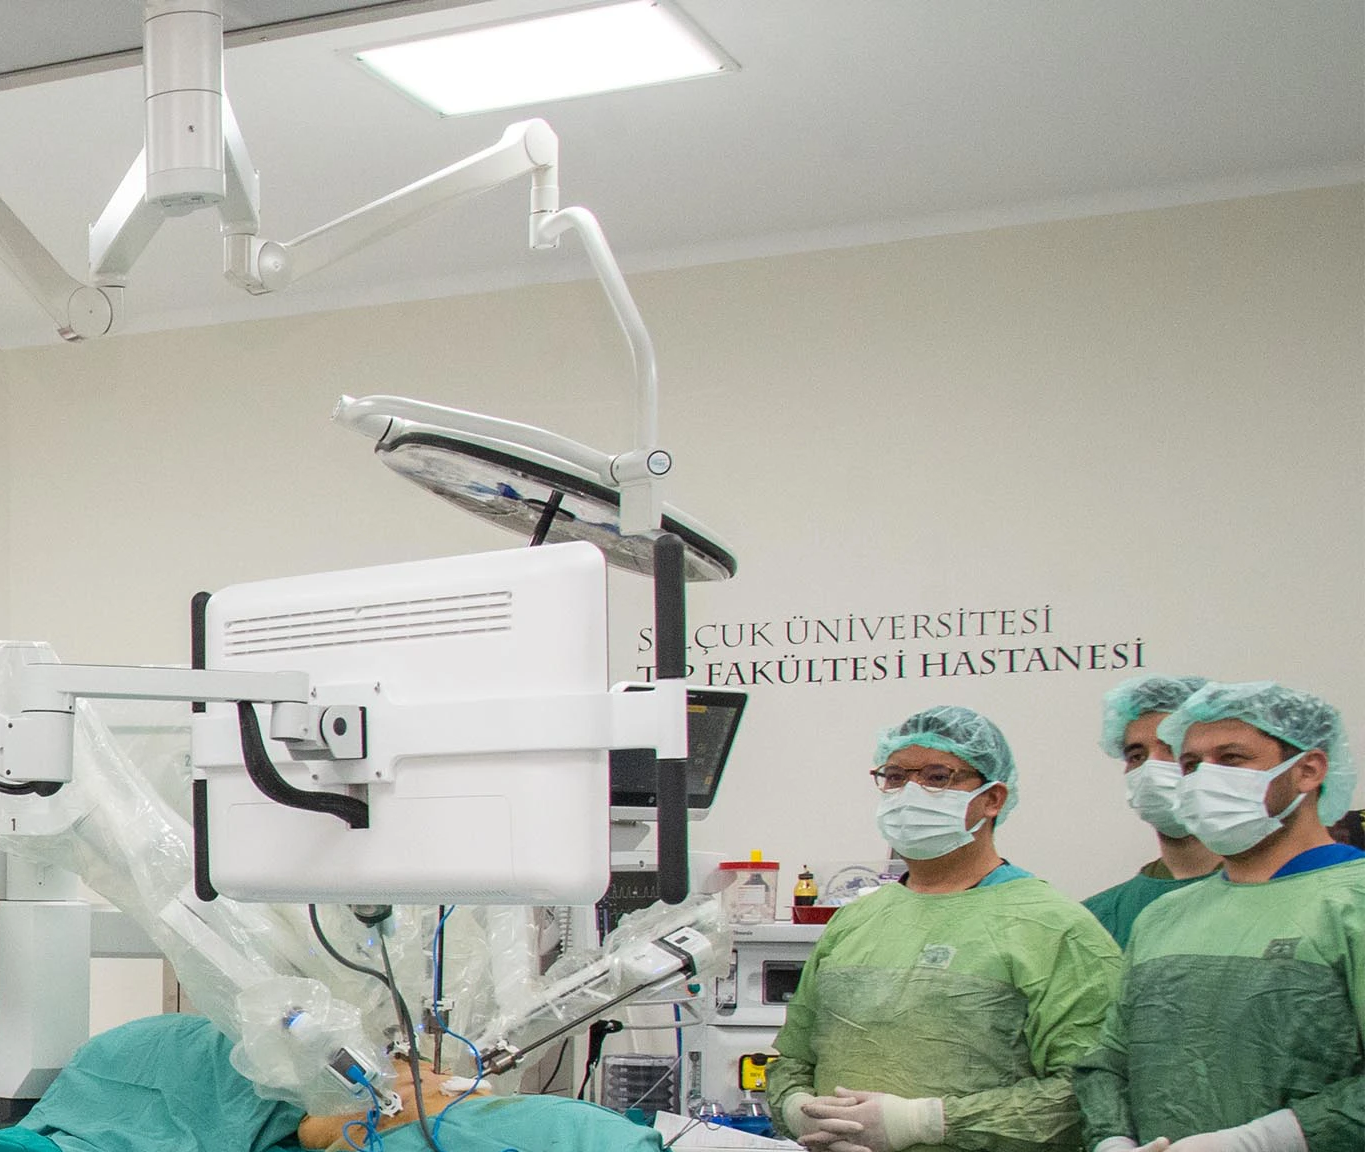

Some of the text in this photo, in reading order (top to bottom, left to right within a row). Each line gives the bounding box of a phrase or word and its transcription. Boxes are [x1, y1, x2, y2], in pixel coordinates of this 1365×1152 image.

[638, 604, 1054, 655] SÇUK ÜNİVERSİTESİ
[705, 650, 907, 686] FAKÜLTESİ
[919, 637, 1147, 678] HASTANESİ
